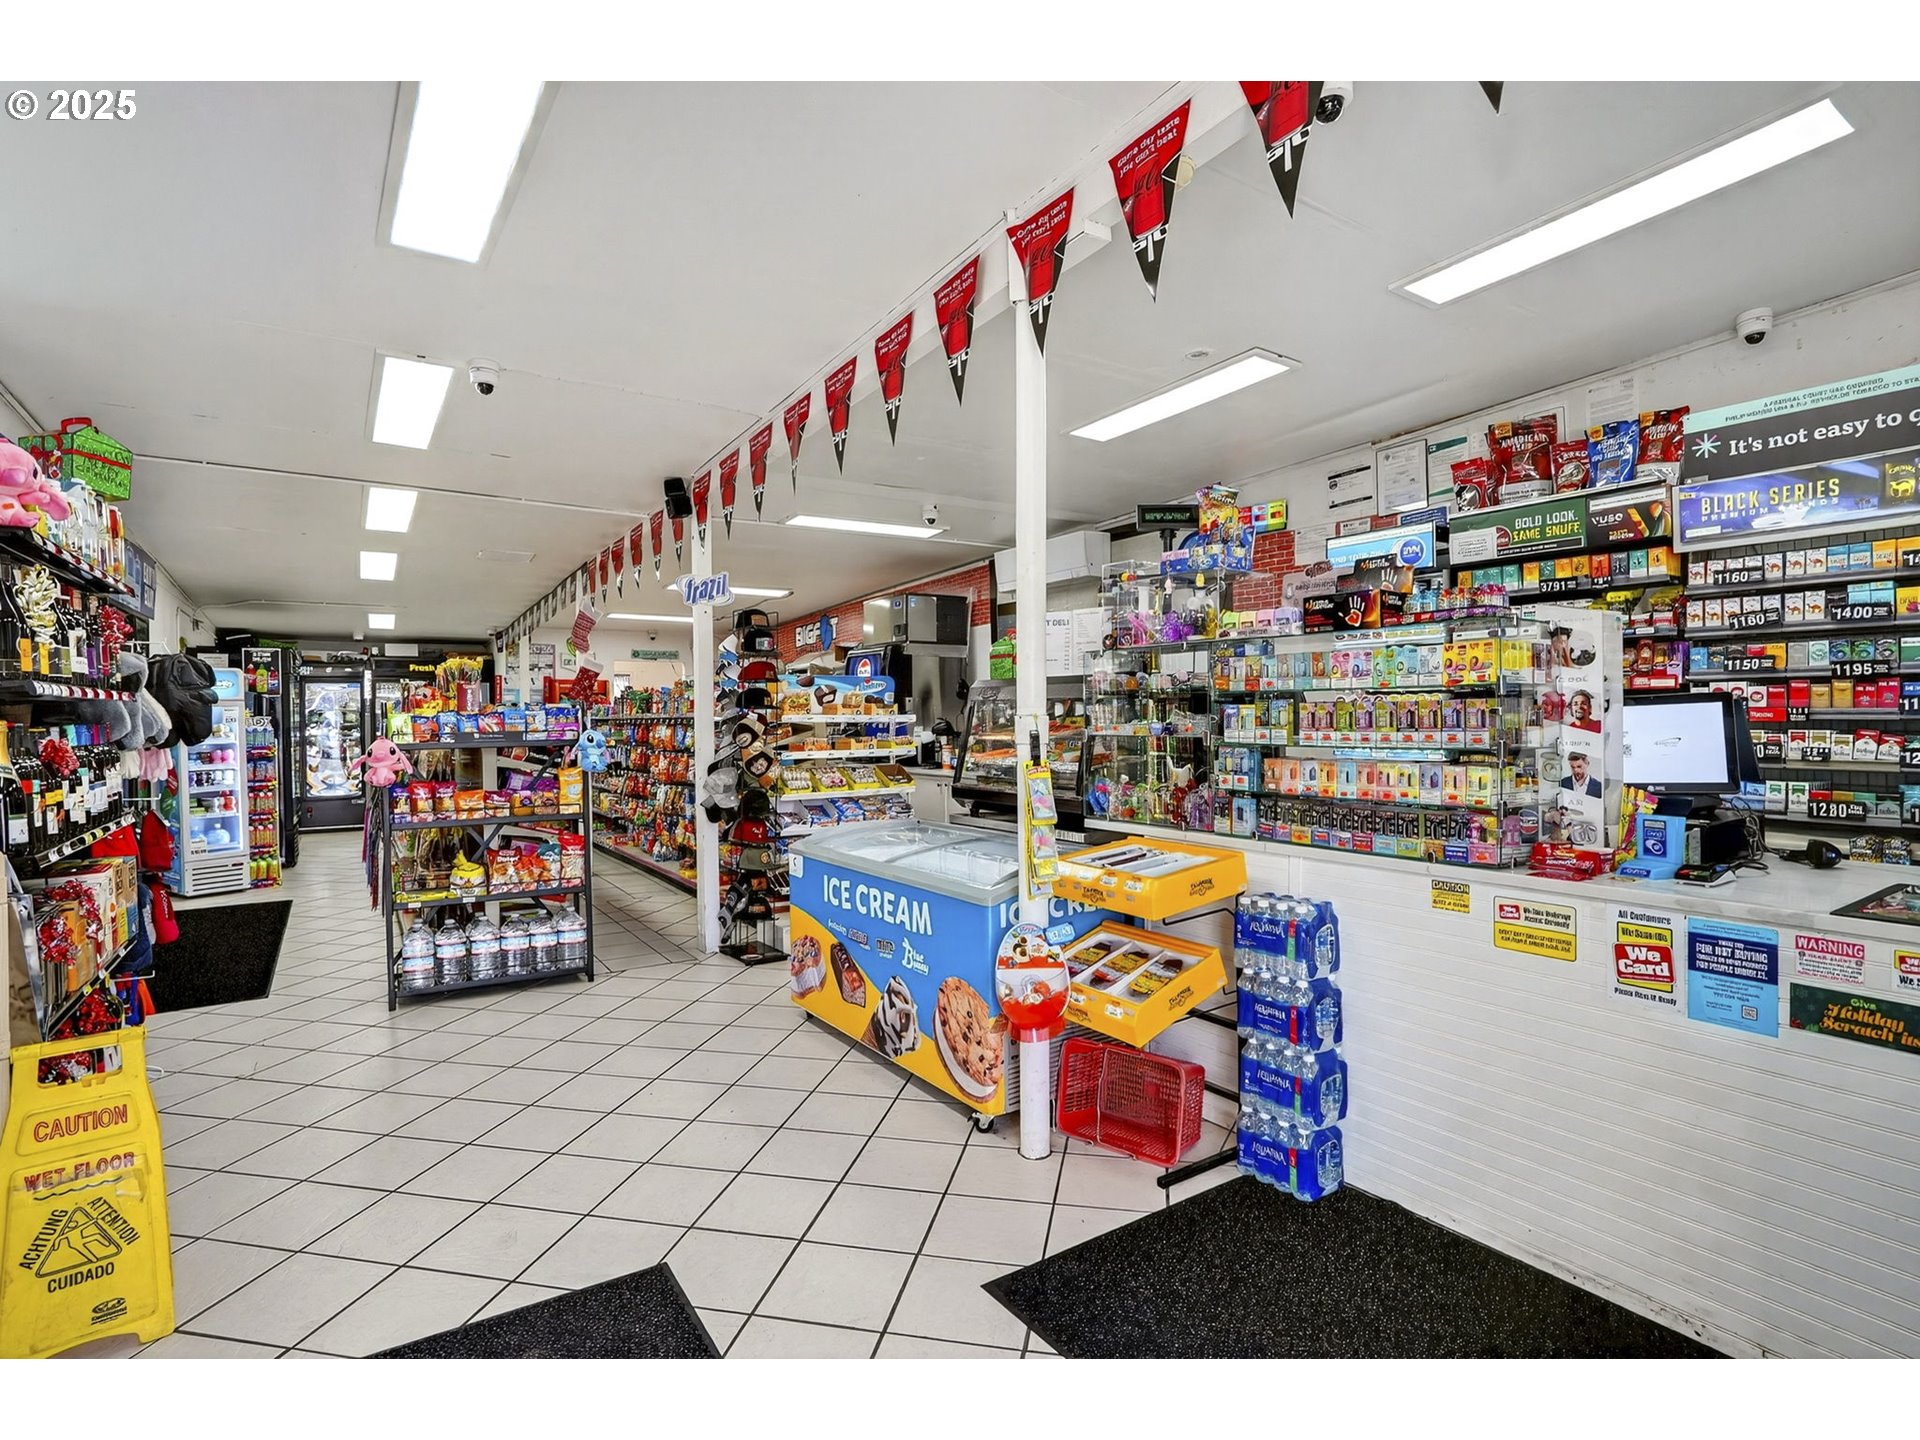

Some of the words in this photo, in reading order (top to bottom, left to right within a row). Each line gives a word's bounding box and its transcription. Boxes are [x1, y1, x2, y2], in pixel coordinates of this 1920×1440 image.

[1728, 436, 1763, 457] It's
[1768, 428, 1809, 450] not
[1813, 417, 1870, 438] easy
[1874, 411, 1903, 430] to
[1701, 489, 1760, 515] BLACK
[1769, 477, 1840, 505] SERIES
[1512, 528, 1541, 542] SAME
[1514, 515, 1542, 529] BOLD
[685, 573, 728, 604] frazil
[823, 874, 852, 910] ICE
[855, 884, 933, 936] CREAM
[1624, 946, 1661, 962] We
[1796, 936, 1864, 958] WARNING
[1618, 959, 1671, 977] Card
[1824, 1003, 1905, 1034] Holiday
[33, 1104, 128, 1143] CAUTION
[24, 1168, 63, 1192] WET
[74, 1152, 135, 1179] FLOOR
[87, 1197, 141, 1246] ATTENTION
[19, 1208, 69, 1271] ACHTUNG
[47, 1262, 115, 1293] CUIDADO
